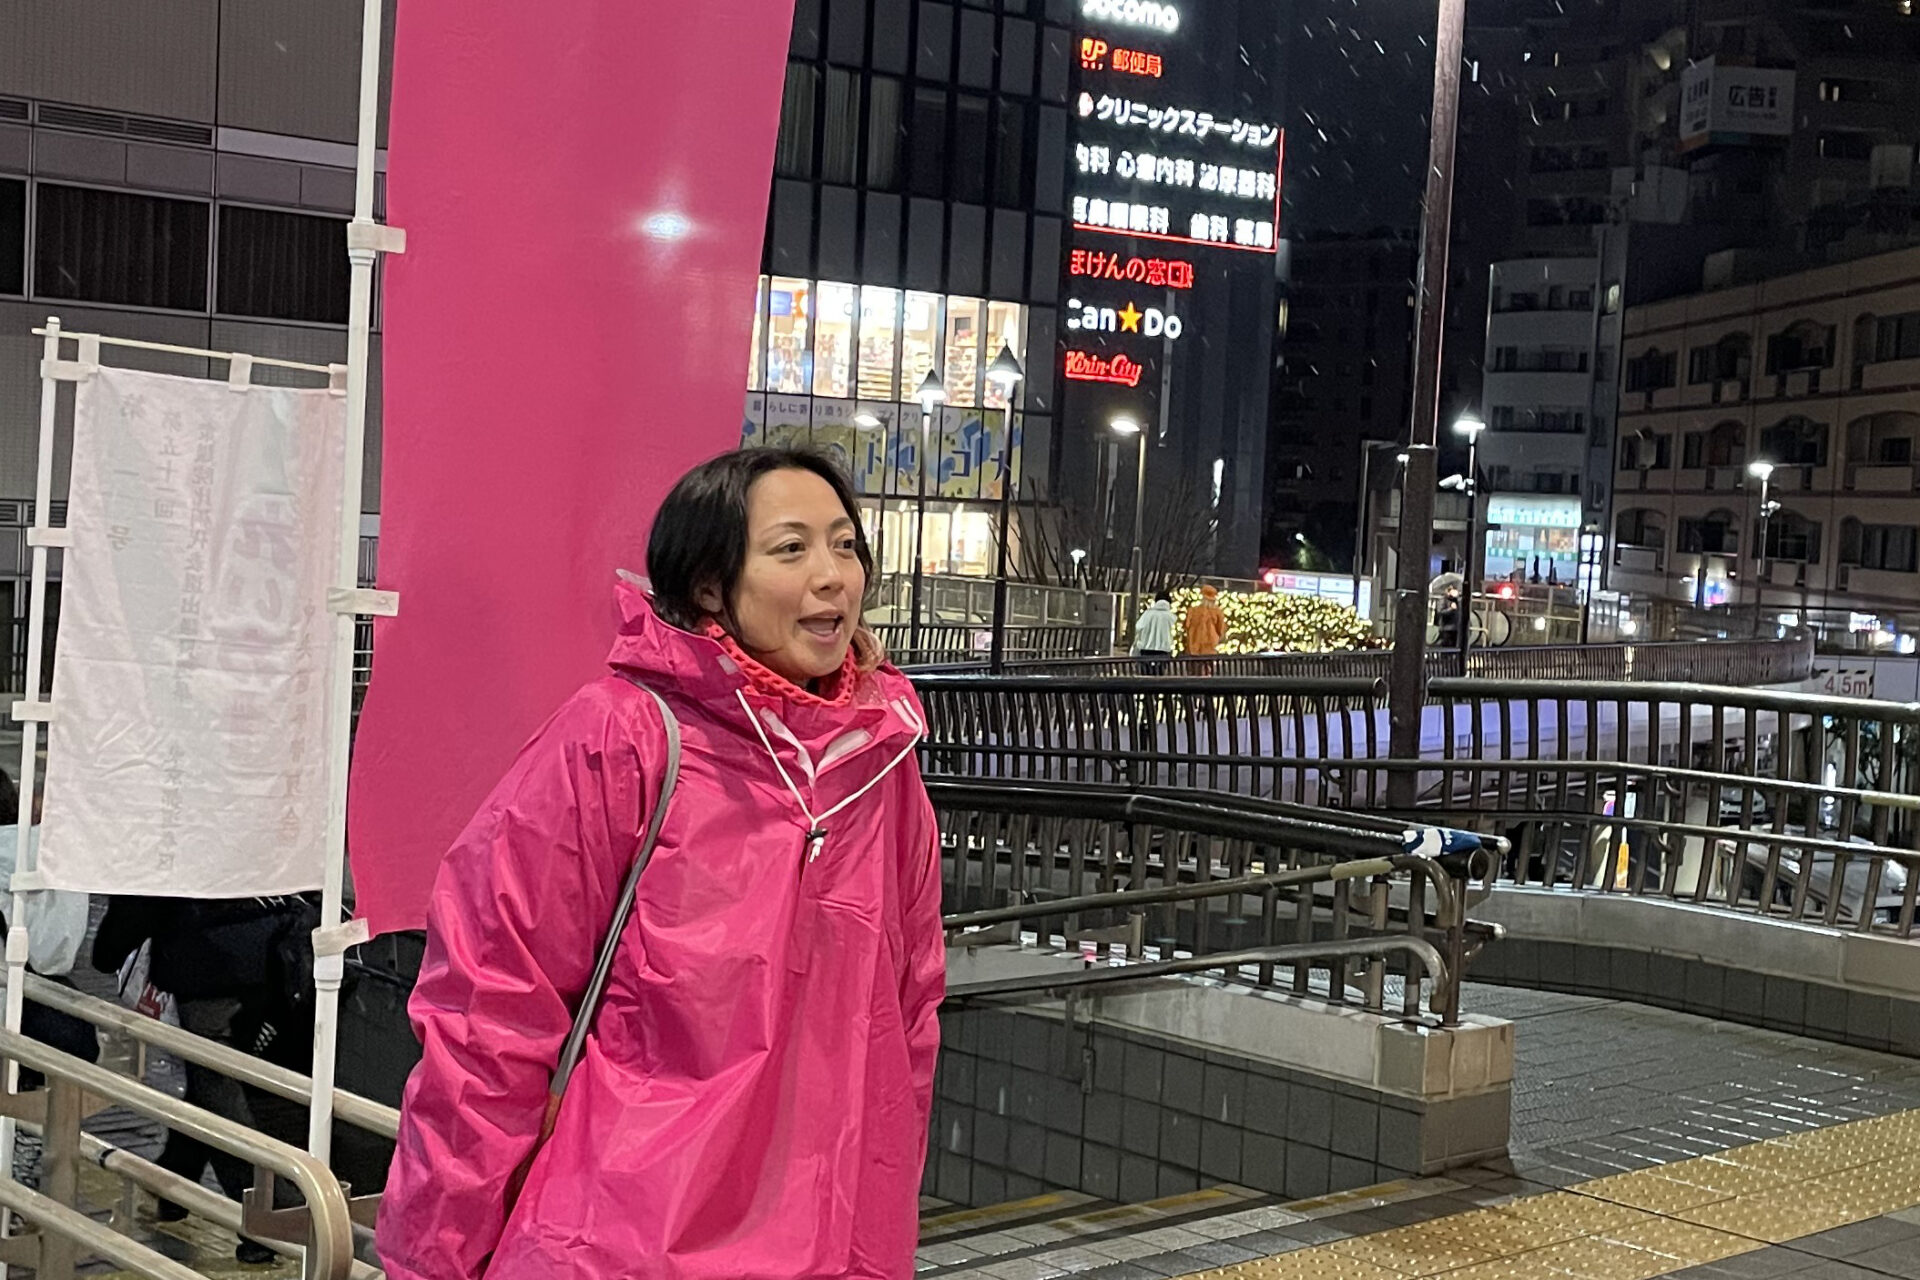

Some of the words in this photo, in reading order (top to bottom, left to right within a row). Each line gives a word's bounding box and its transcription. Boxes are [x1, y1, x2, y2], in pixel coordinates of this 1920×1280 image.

[1112, 48, 1163, 78] 郵便局
[1729, 84, 1765, 108] 広告
[1096, 94, 1279, 147] クリニックステーション
